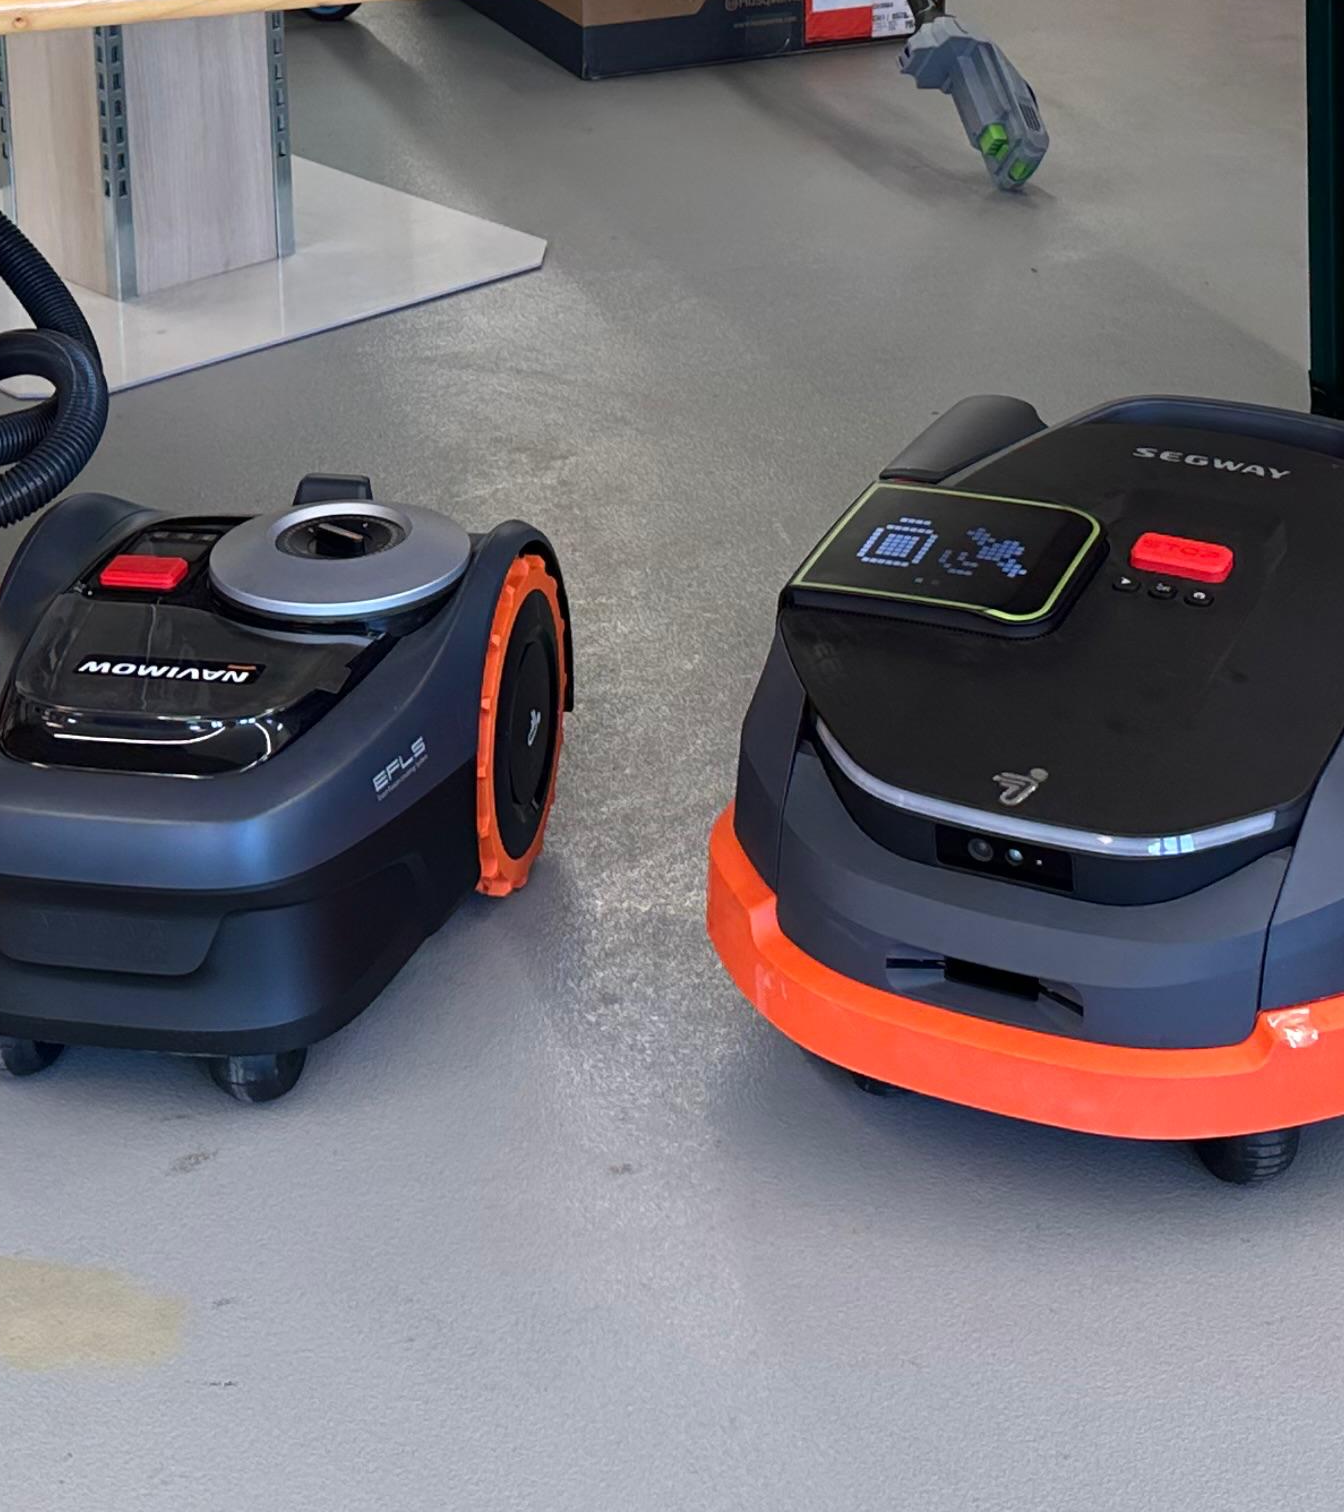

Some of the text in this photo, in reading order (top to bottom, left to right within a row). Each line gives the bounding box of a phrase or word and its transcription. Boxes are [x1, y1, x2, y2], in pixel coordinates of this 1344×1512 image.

[1132, 446, 1292, 480] SEGWAY
[78, 660, 251, 684] NAVIMOW
[372, 735, 426, 793] EFLS
